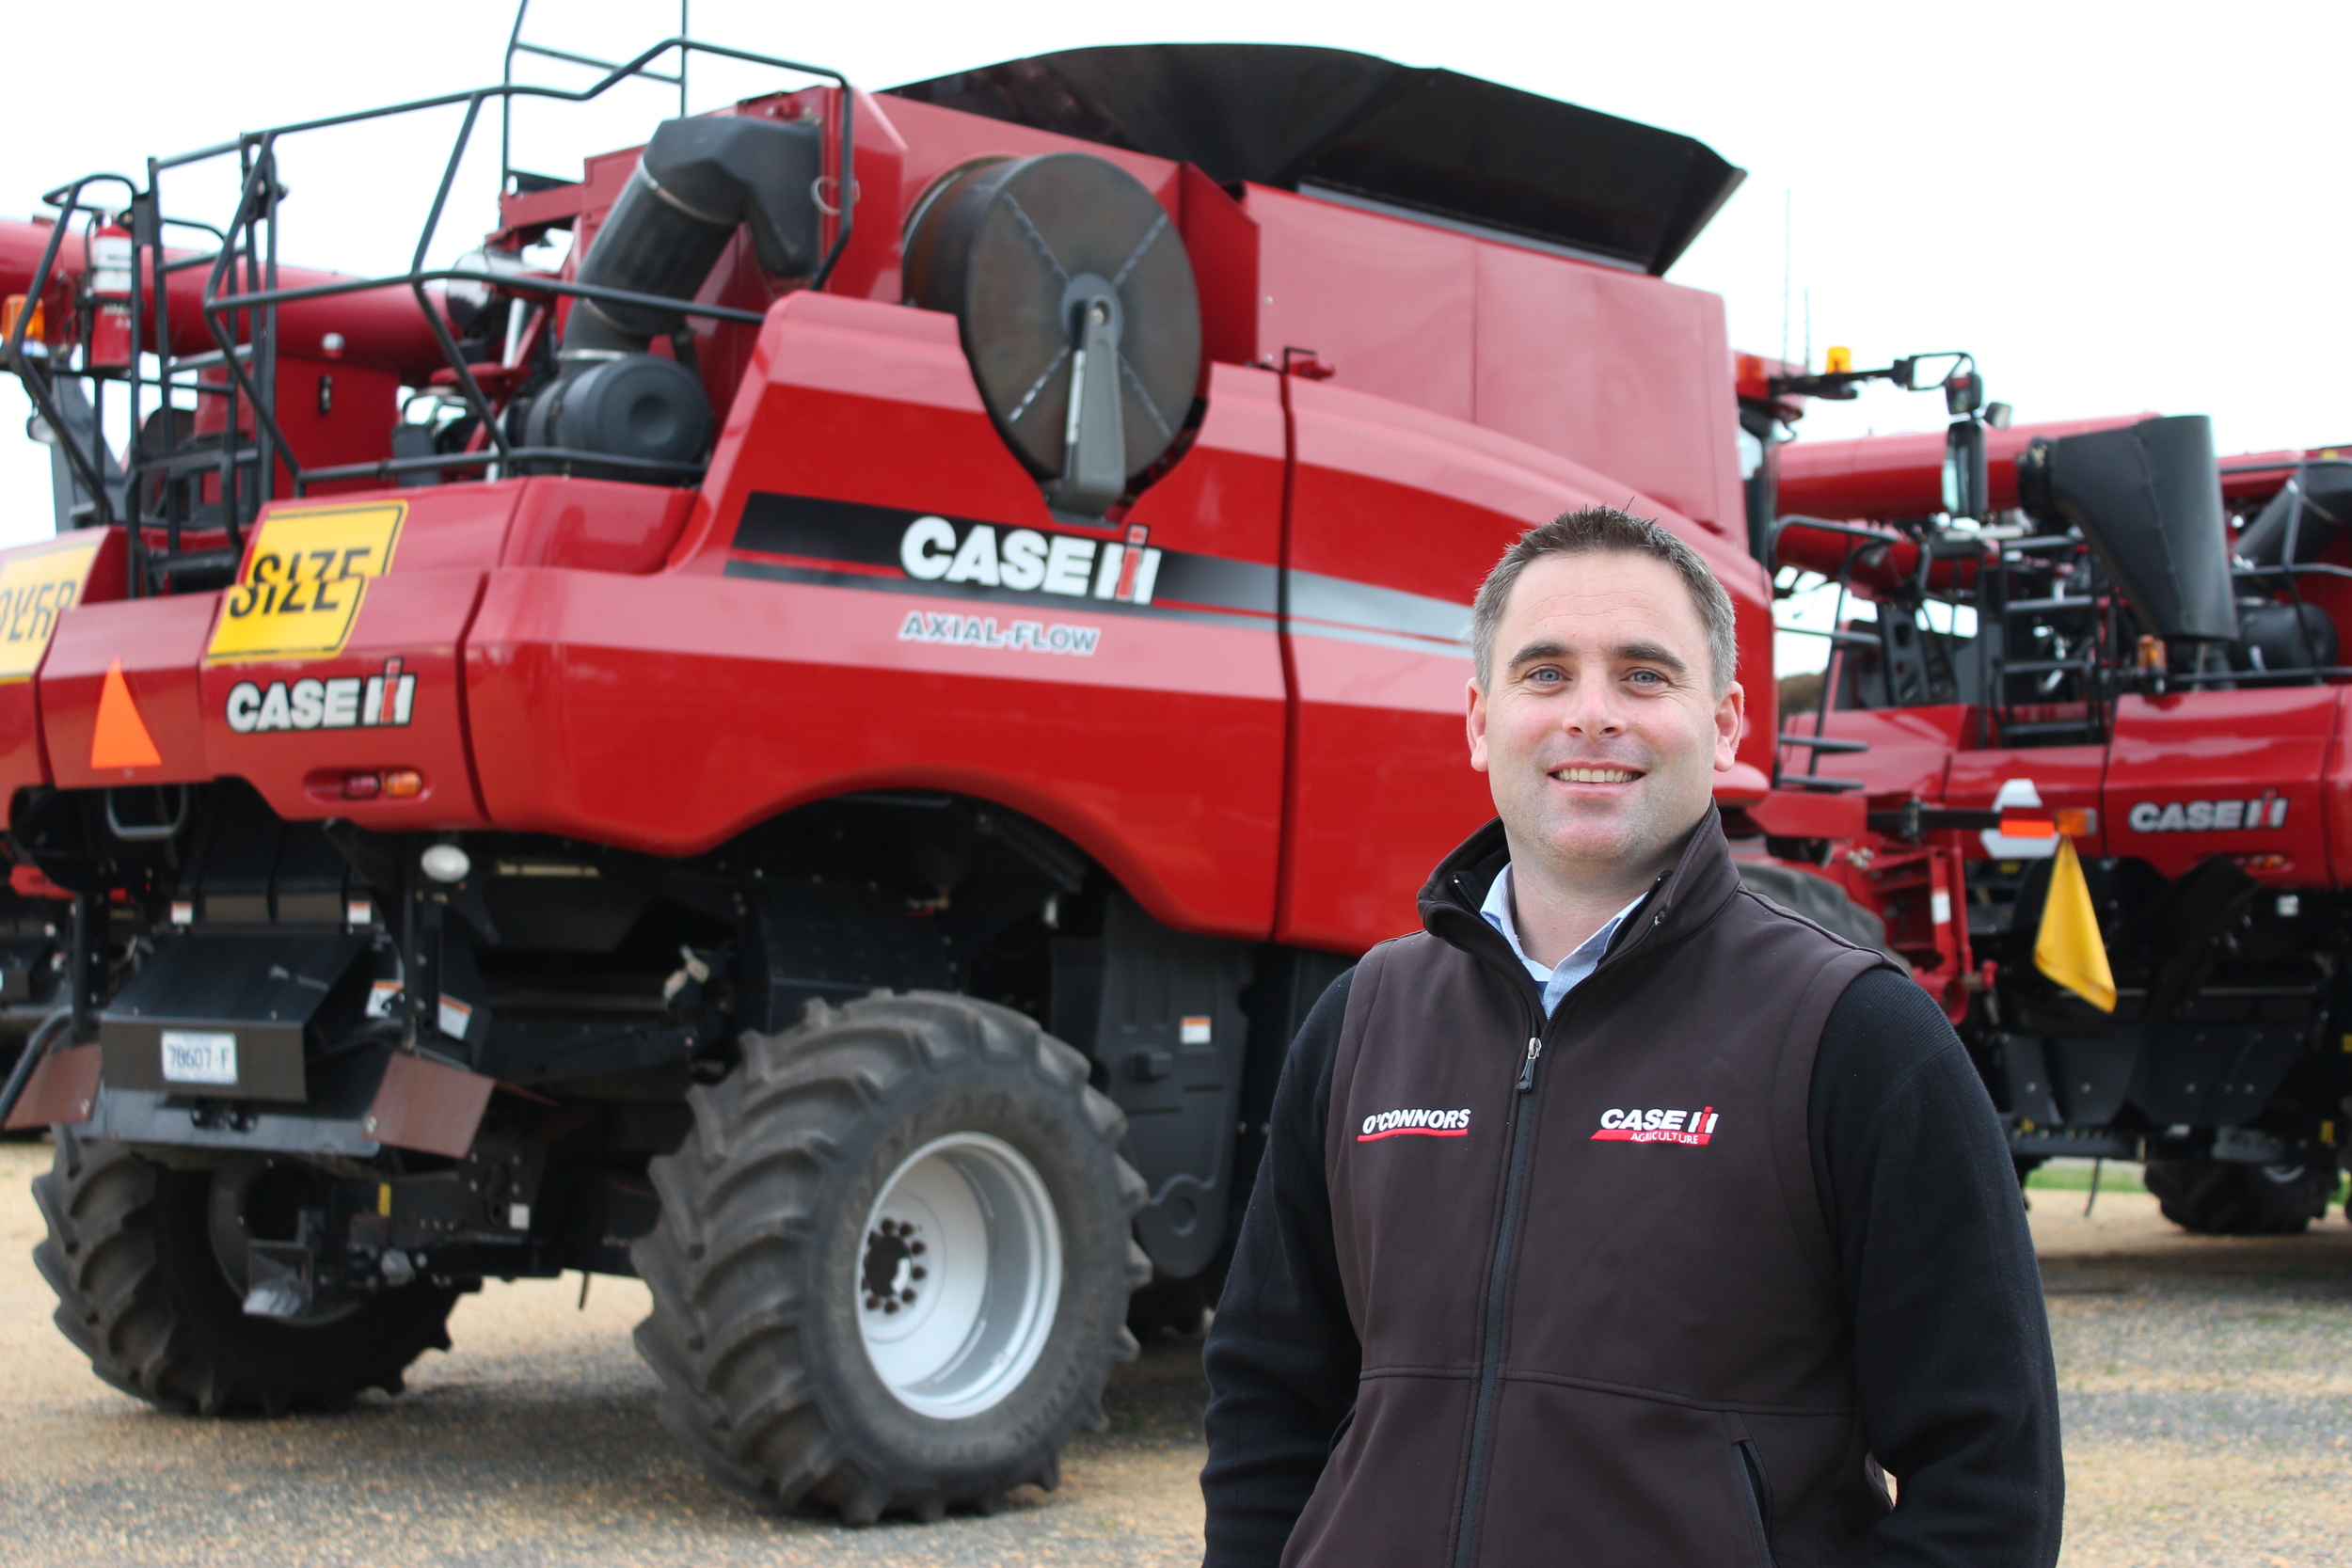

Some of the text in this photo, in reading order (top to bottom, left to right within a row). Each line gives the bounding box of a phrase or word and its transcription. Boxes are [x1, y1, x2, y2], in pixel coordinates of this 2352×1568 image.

[900, 516, 1097, 596] CASE
[230, 547, 371, 619] SIZE
[900, 611, 1100, 656] AXIAL-FLOW
[226, 677, 361, 733] CASE
[2128, 800, 2246, 832] CASE
[1362, 1108, 1471, 1134] O'CONNORS
[1600, 1108, 1688, 1132] CASE
[1629, 1131, 1699, 1145] AGRICULTURE
